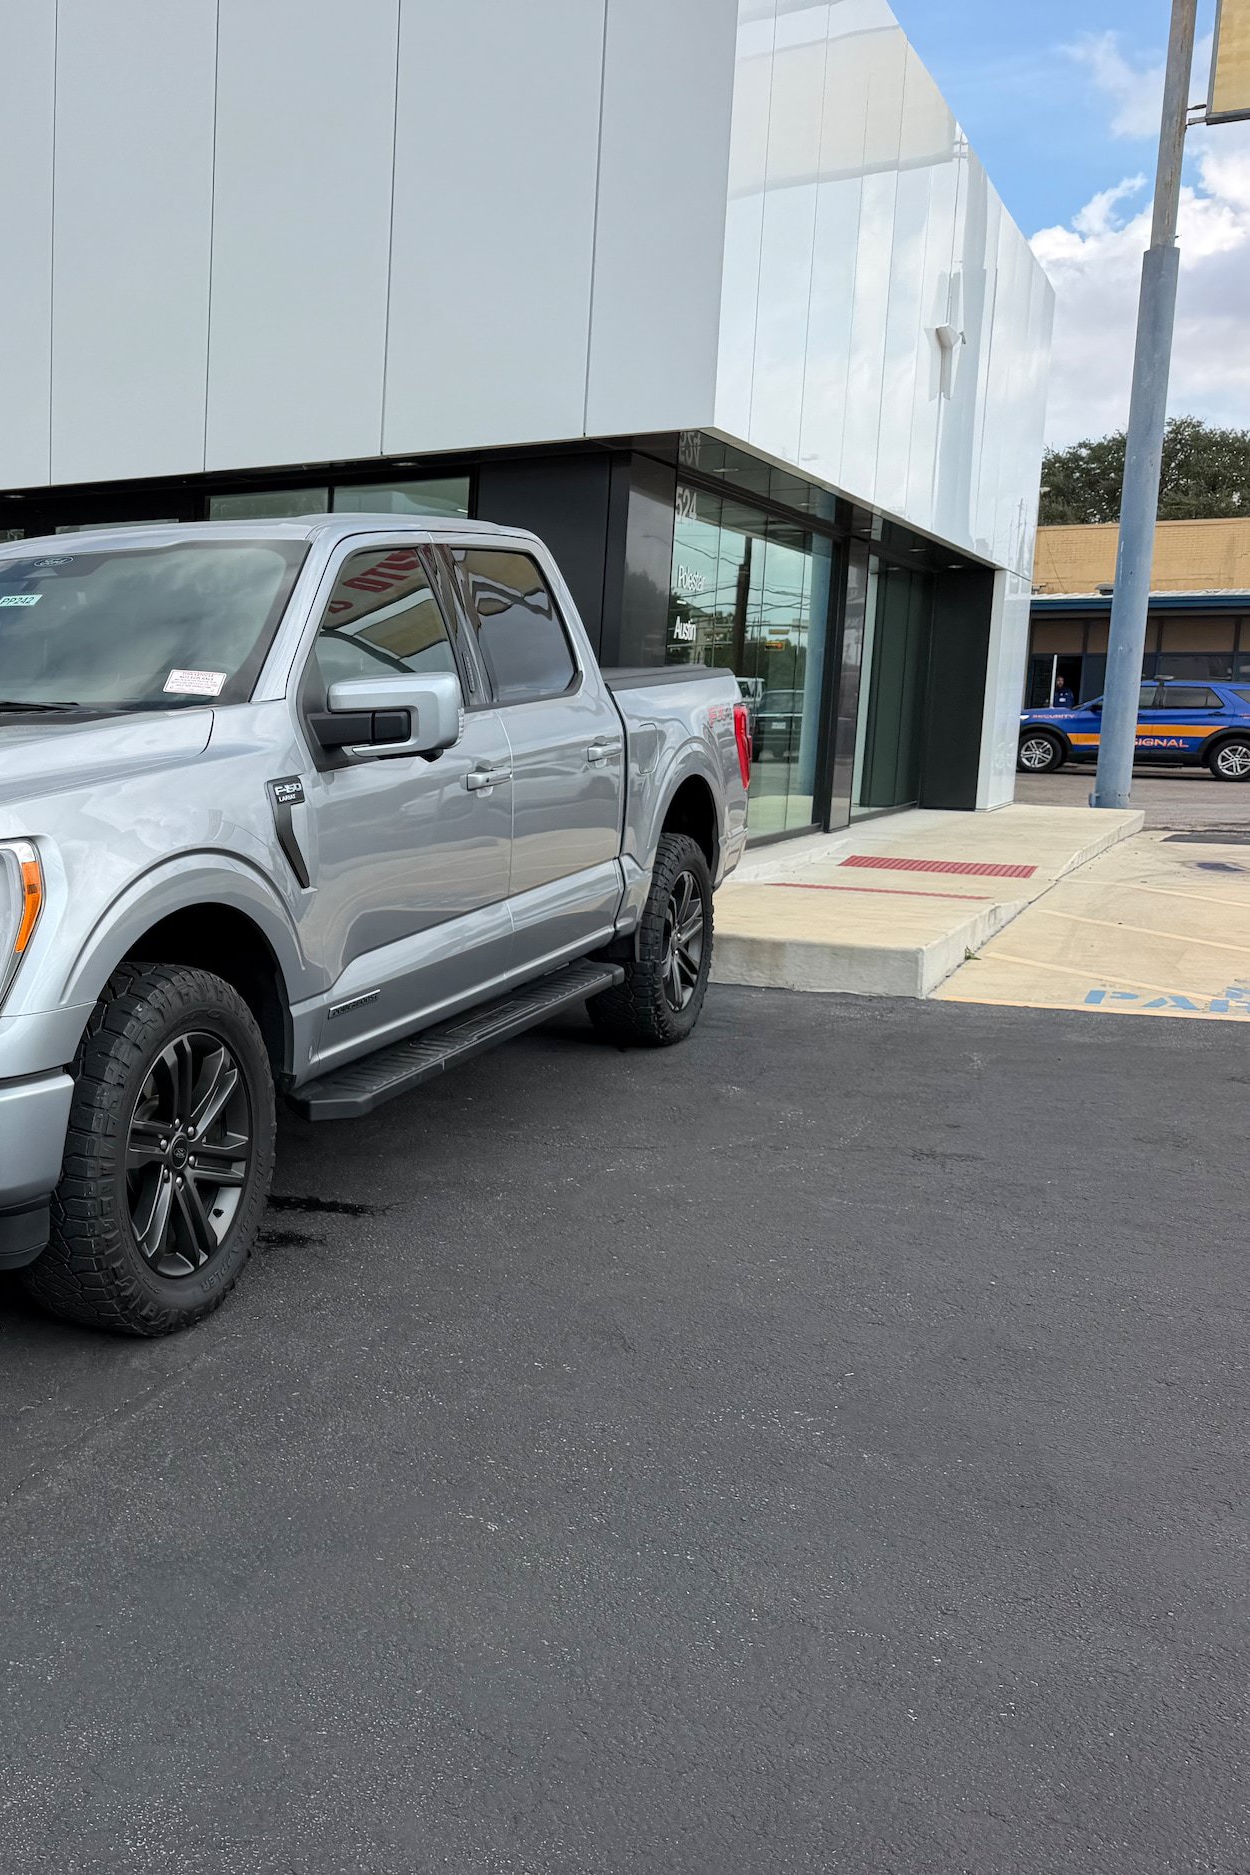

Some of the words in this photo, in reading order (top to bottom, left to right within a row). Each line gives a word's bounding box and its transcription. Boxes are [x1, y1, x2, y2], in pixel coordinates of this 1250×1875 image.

[675, 486, 697, 520] 524
[677, 564, 705, 592] Polestar
[0, 596, 35, 605] PP242
[673, 615, 696, 641] Austin
[274, 783, 302, 795] F-150
